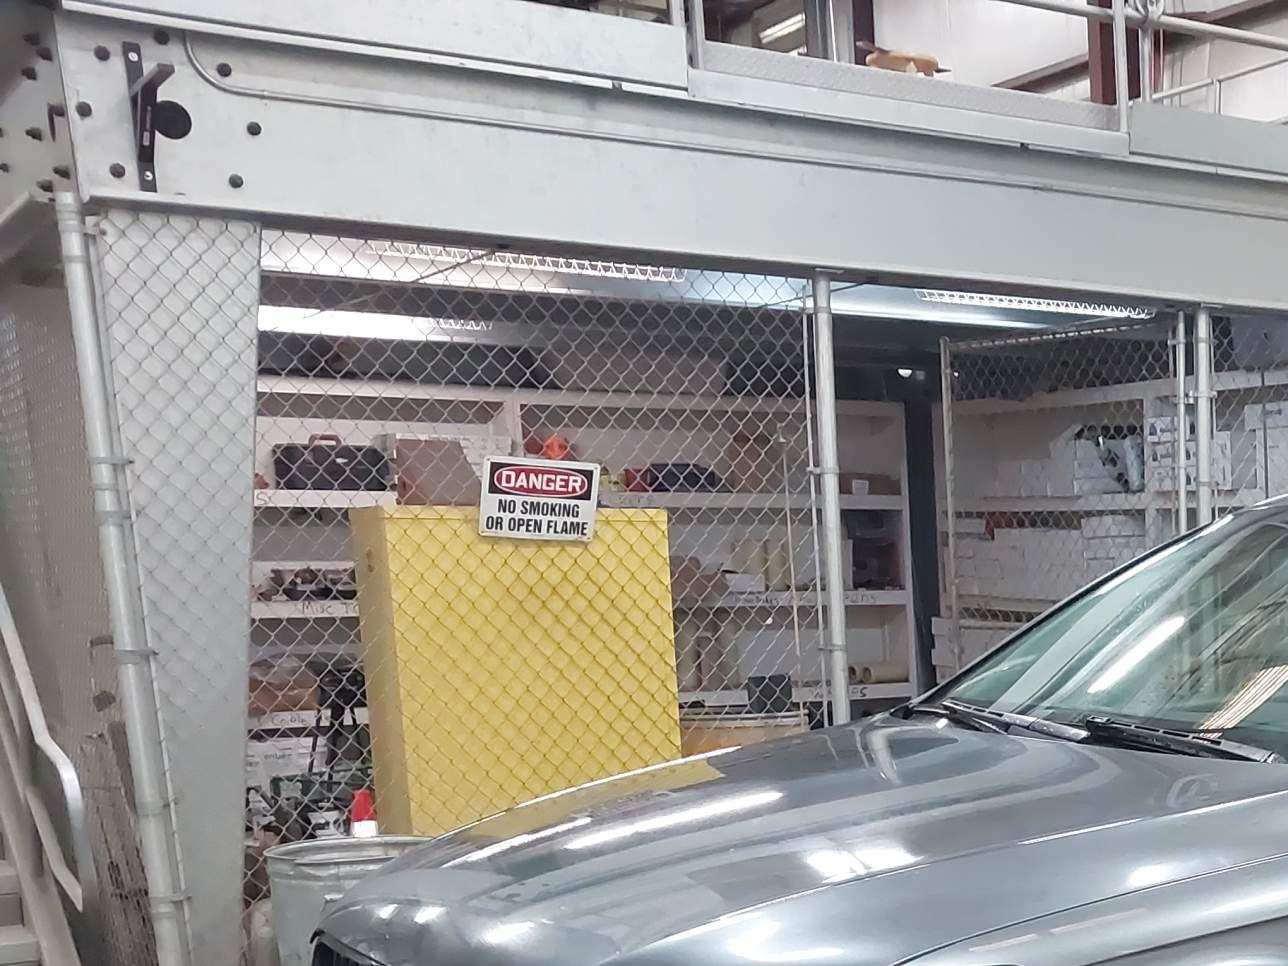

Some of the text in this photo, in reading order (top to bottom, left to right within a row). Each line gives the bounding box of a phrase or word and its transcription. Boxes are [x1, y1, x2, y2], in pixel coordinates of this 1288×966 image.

[501, 470, 582, 492] DANGER
[497, 498, 580, 518] NO SMOKING
[486, 515, 588, 536] OR OPEN FLAME
